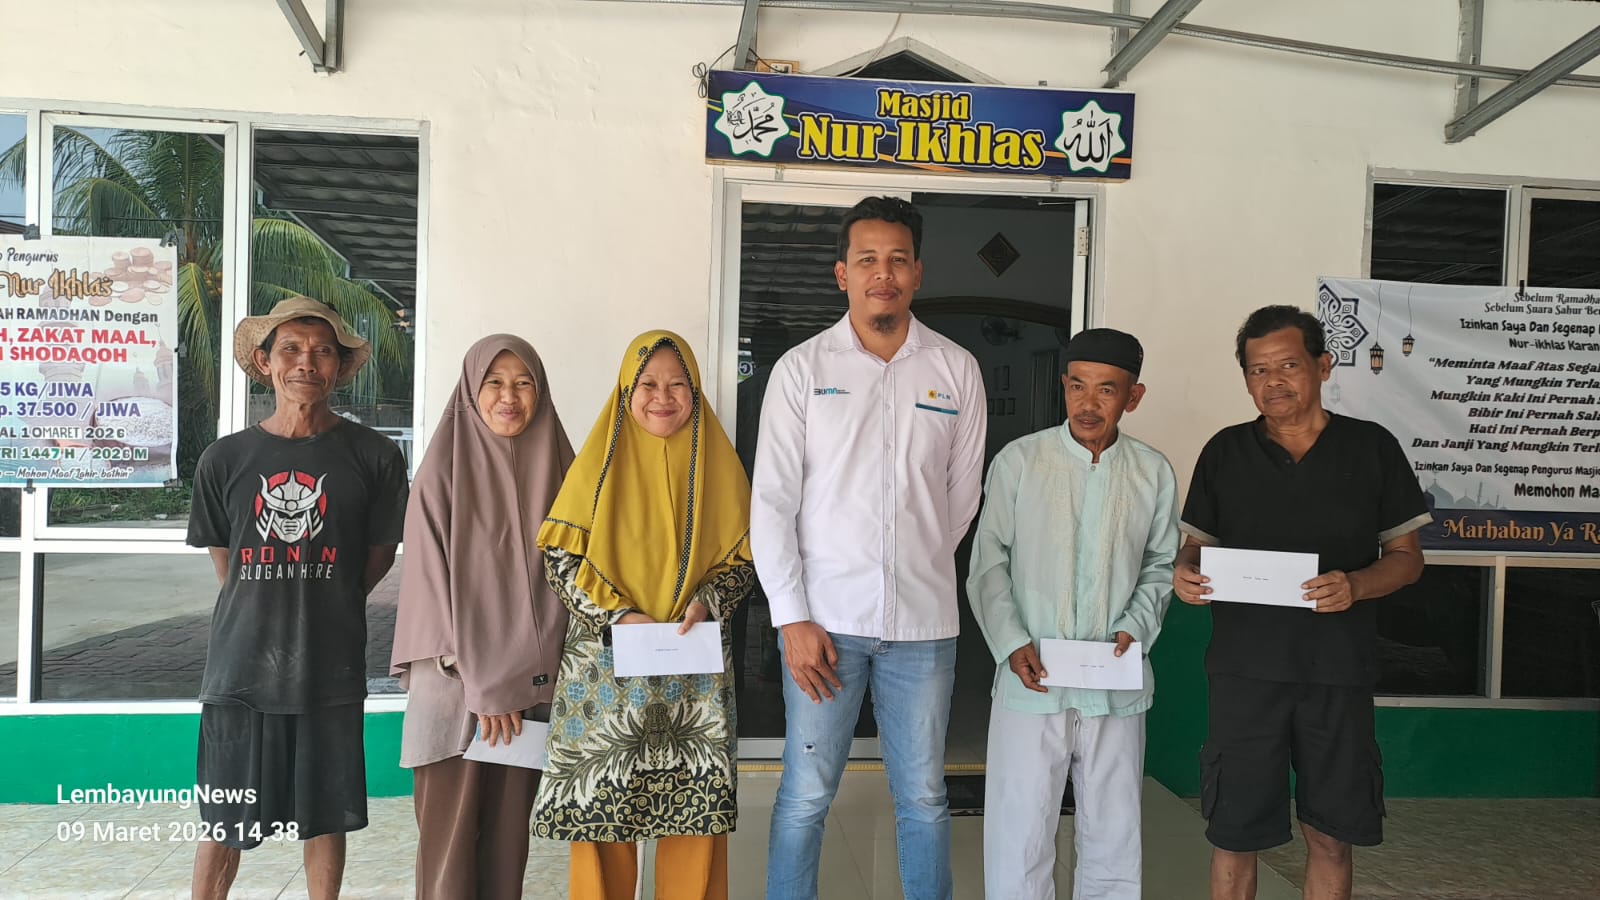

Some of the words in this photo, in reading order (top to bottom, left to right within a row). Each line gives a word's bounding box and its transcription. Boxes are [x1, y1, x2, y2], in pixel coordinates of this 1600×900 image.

[879, 90, 970, 121] Masjid
[800, 114, 884, 160] Nur
[896, 120, 1045, 168] Ikhlas
[7, 247, 59, 266] Pengurus
[1, 270, 45, 298] Nur
[48, 268, 113, 301] Ikhlas
[1514, 292, 1553, 303] Sebelum
[17, 308, 100, 321] RAMADHAN
[104, 310, 158, 325] Dengan
[1485, 303, 1524, 313] Sebelum
[1526, 304, 1553, 314] Suara
[1555, 305, 1582, 315] Sahur
[1460, 319, 1499, 330] Izinkan
[1502, 320, 1526, 335] Saya
[1529, 321, 1549, 333] Dan
[1552, 321, 1595, 337] Segenap
[18, 328, 85, 343] ZAKAT
[92, 330, 156, 347] MAAL,
[10, 346, 127, 364] SHODAQOH
[1498, 360, 1535, 371] Maaf
[1535, 362, 1565, 372] Atas
[1467, 375, 1501, 388] Yang
[1502, 376, 1562, 389] Mungkin
[1431, 390, 1491, 403] Mungkin
[1493, 392, 1525, 403] Kaki
[1526, 393, 1546, 403] Ini
[1548, 394, 1595, 404] Pernah
[17, 403, 76, 416] 37.500
[97, 403, 140, 417] JIWA
[1468, 407, 1503, 418] Bibir
[1505, 409, 1525, 419] Ini
[1526, 409, 1574, 420] Pernah
[86, 428, 125, 439] 2026
[1469, 424, 1497, 434] Hati
[1499, 425, 1518, 435] Ini
[1520, 425, 1567, 436] Pernah
[0, 448, 16, 459] RI
[22, 448, 60, 459] 1447
[1412, 438, 1439, 448] Dan
[1441, 439, 1474, 451] Janji
[1477, 439, 1509, 452] Yang
[1511, 441, 1569, 453] Mungkin
[1573, 442, 1600, 452] Terl
[1415, 461, 1449, 472] Izinkan
[1451, 462, 1473, 474] Saya
[1475, 463, 1492, 472] Dan
[1494, 463, 1529, 477] Segenap
[1532, 465, 1573, 478] Pengurus
[1514, 483, 1574, 498] Memohon
[1579, 485, 1600, 498] Ma
[1441, 516, 1545, 541] Marhaban
[1547, 521, 1574, 546] Ya
[240, 545, 337, 564] RONIN
[240, 563, 296, 580] SLOGAN
[300, 563, 334, 579] HERE
